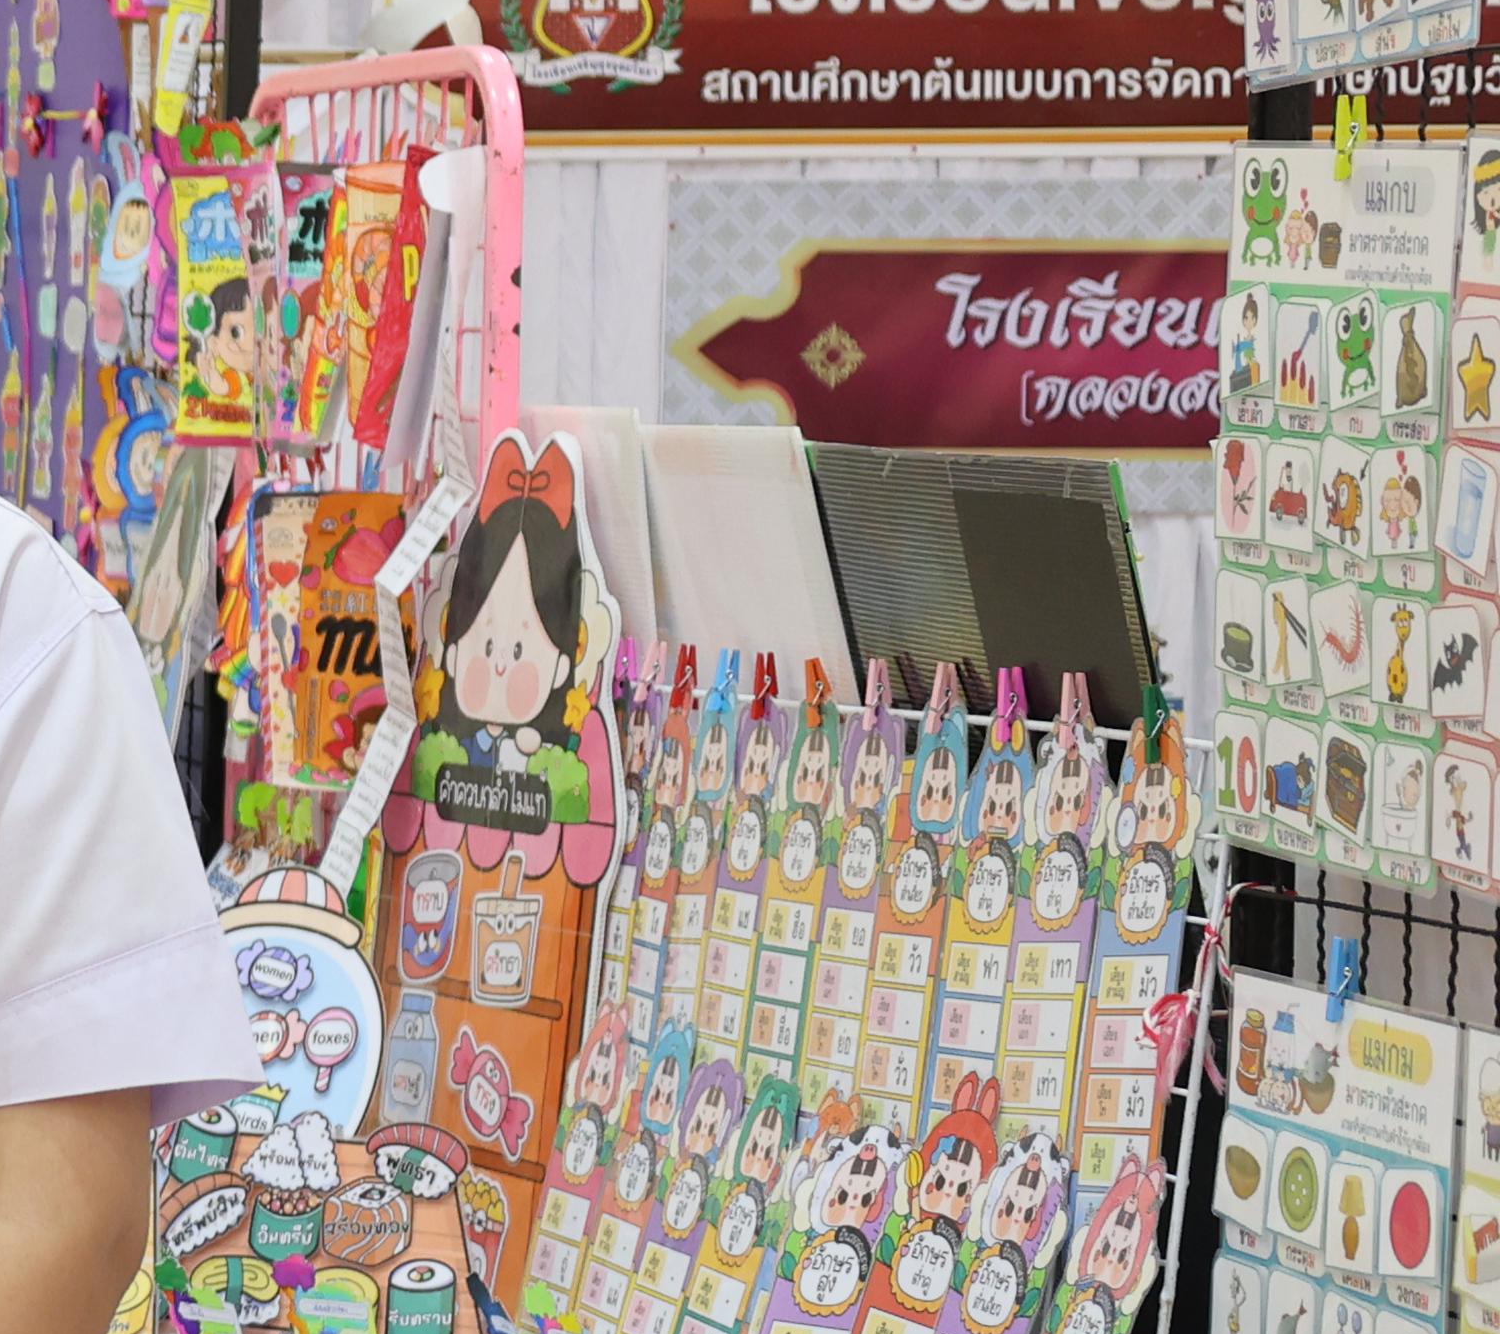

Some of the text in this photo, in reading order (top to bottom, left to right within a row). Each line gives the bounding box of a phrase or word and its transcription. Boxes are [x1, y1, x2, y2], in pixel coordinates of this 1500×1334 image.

[1365, 158, 1417, 215] แม่กบ
[254, 962, 293, 982] women
[311, 1029, 351, 1045] foxes
[1362, 1017, 1415, 1081] แม่กม
